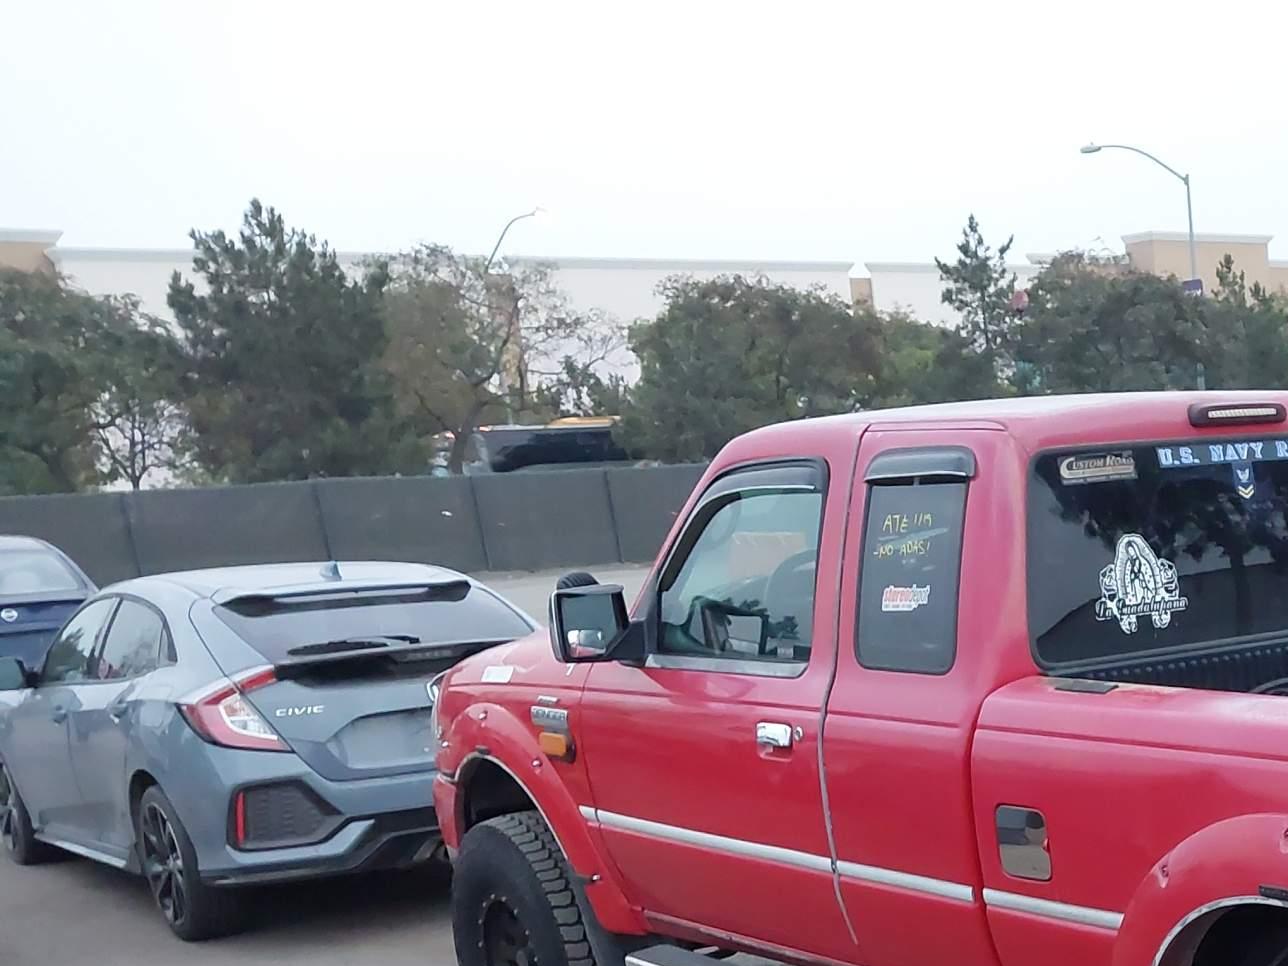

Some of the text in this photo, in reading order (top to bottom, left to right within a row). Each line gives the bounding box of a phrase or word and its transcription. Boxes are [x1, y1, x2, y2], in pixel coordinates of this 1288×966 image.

[1158, 447, 1200, 465] U.S.
[1209, 442, 1263, 462] NAVY
[275, 704, 325, 717] CIVIC
